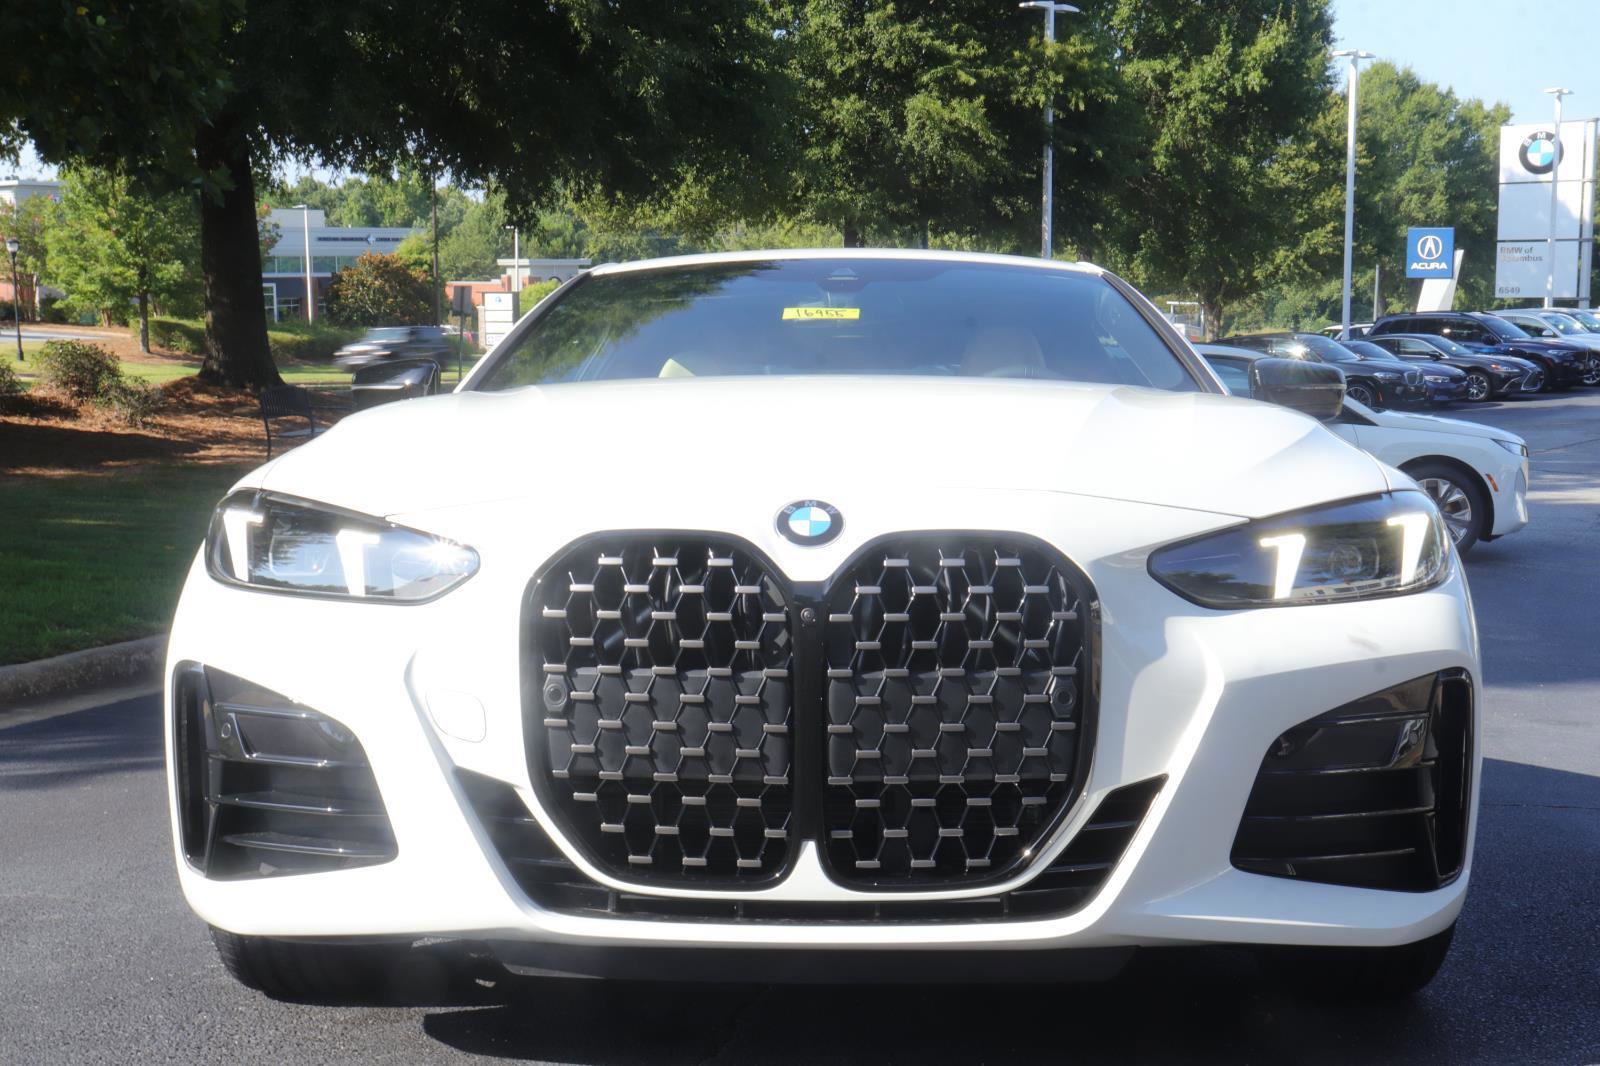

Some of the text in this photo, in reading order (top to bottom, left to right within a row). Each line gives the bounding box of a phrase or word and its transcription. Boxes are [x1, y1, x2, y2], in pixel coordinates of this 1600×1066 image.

[1525, 246, 1534, 254] of
[1410, 261, 1449, 270] ACURA
[1498, 286, 1521, 294] 6549
[783, 500, 838, 514] BMW
